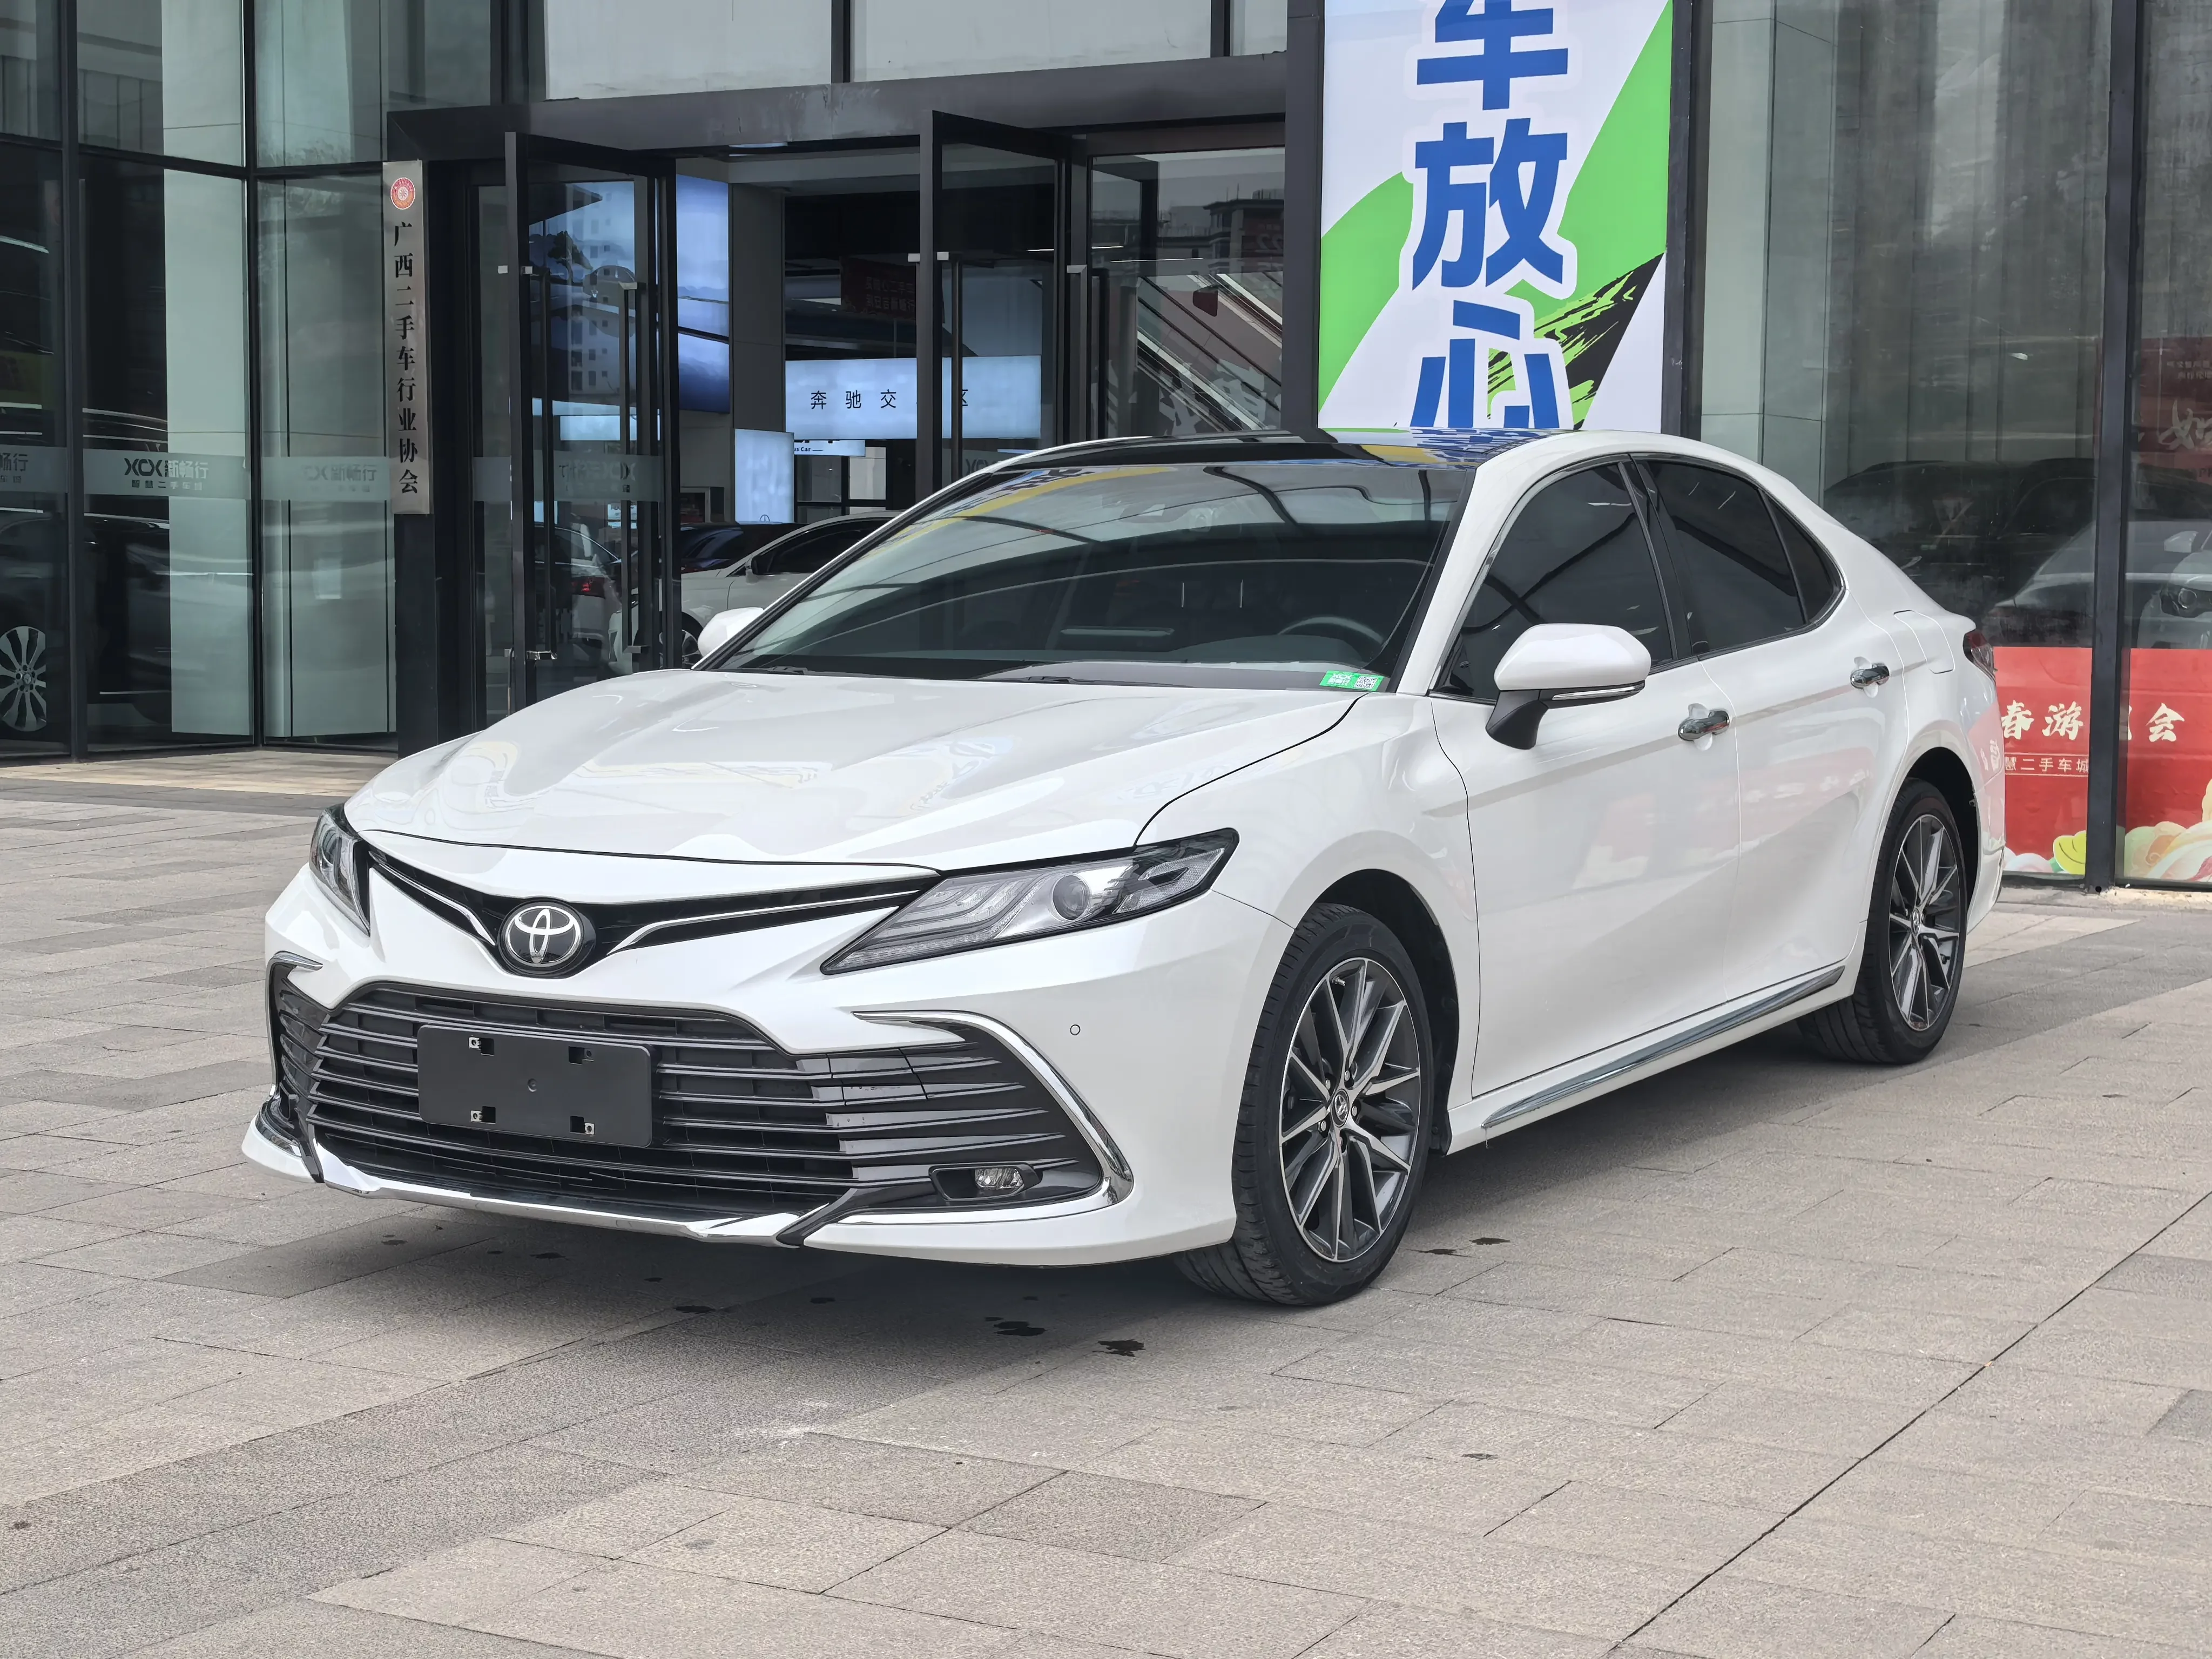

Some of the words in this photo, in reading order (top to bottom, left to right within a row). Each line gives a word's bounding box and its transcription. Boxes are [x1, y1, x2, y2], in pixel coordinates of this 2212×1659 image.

[394, 221, 418, 494] 广西二手车行业协会
[811, 389, 968, 410] 奔驰交
[2001, 700, 2185, 743] 春游会
